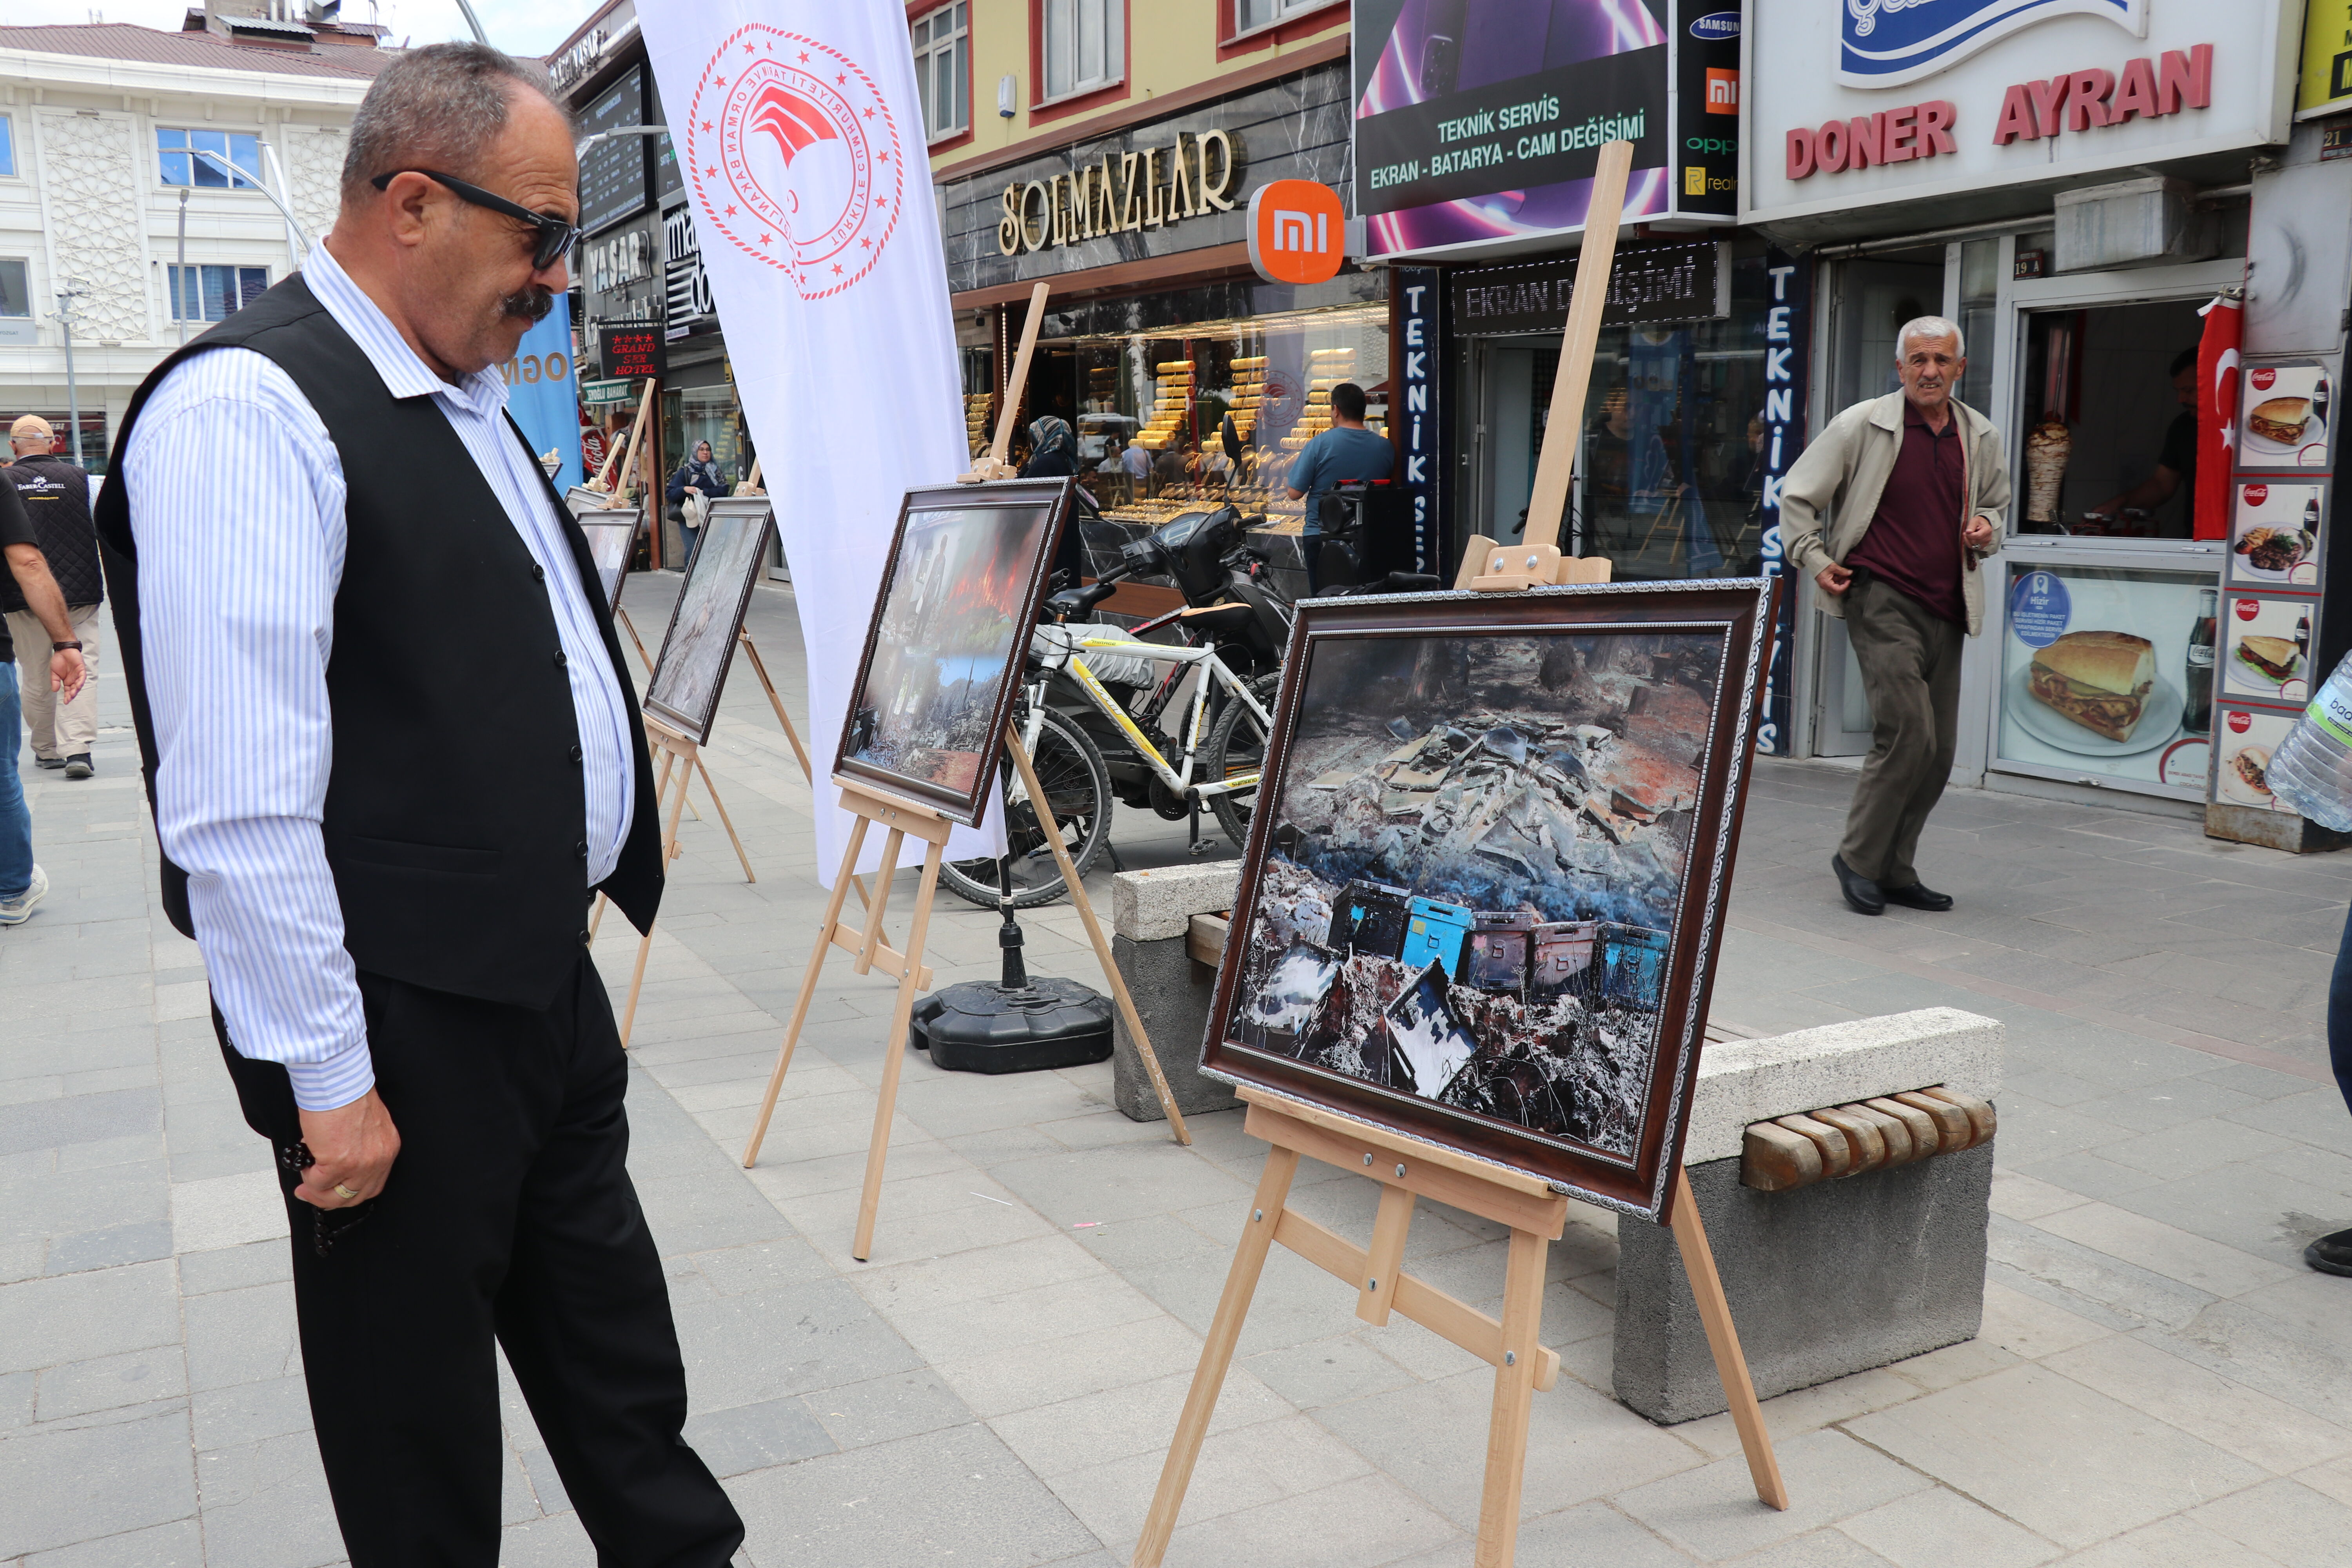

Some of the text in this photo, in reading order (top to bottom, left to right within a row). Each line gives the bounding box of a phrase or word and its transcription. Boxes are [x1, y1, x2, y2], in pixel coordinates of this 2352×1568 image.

[1699, 18, 1739, 31] SAMSUN
[1437, 93, 1559, 143] TEKNİK SERVİS
[1786, 44, 2213, 180] DONER AYRAN
[1687, 137, 1739, 155] opp
[2323, 131, 2341, 147] 21
[1371, 159, 1419, 189] EKRAN
[1432, 142, 1503, 176] BATARYA
[1517, 131, 1555, 160] CAM
[999, 128, 1235, 256] SOLMAZLAR
[1708, 176, 1738, 191] real
[2015, 262, 2027, 274] 19
[1466, 256, 1695, 317] EKRAN DİŞİMİ
[612, 343, 656, 354] GRAND
[614, 364, 657, 375] HOTEL
[607, 384, 628, 399] BAHARAT
[1406, 285, 1426, 482] TEKNİK
